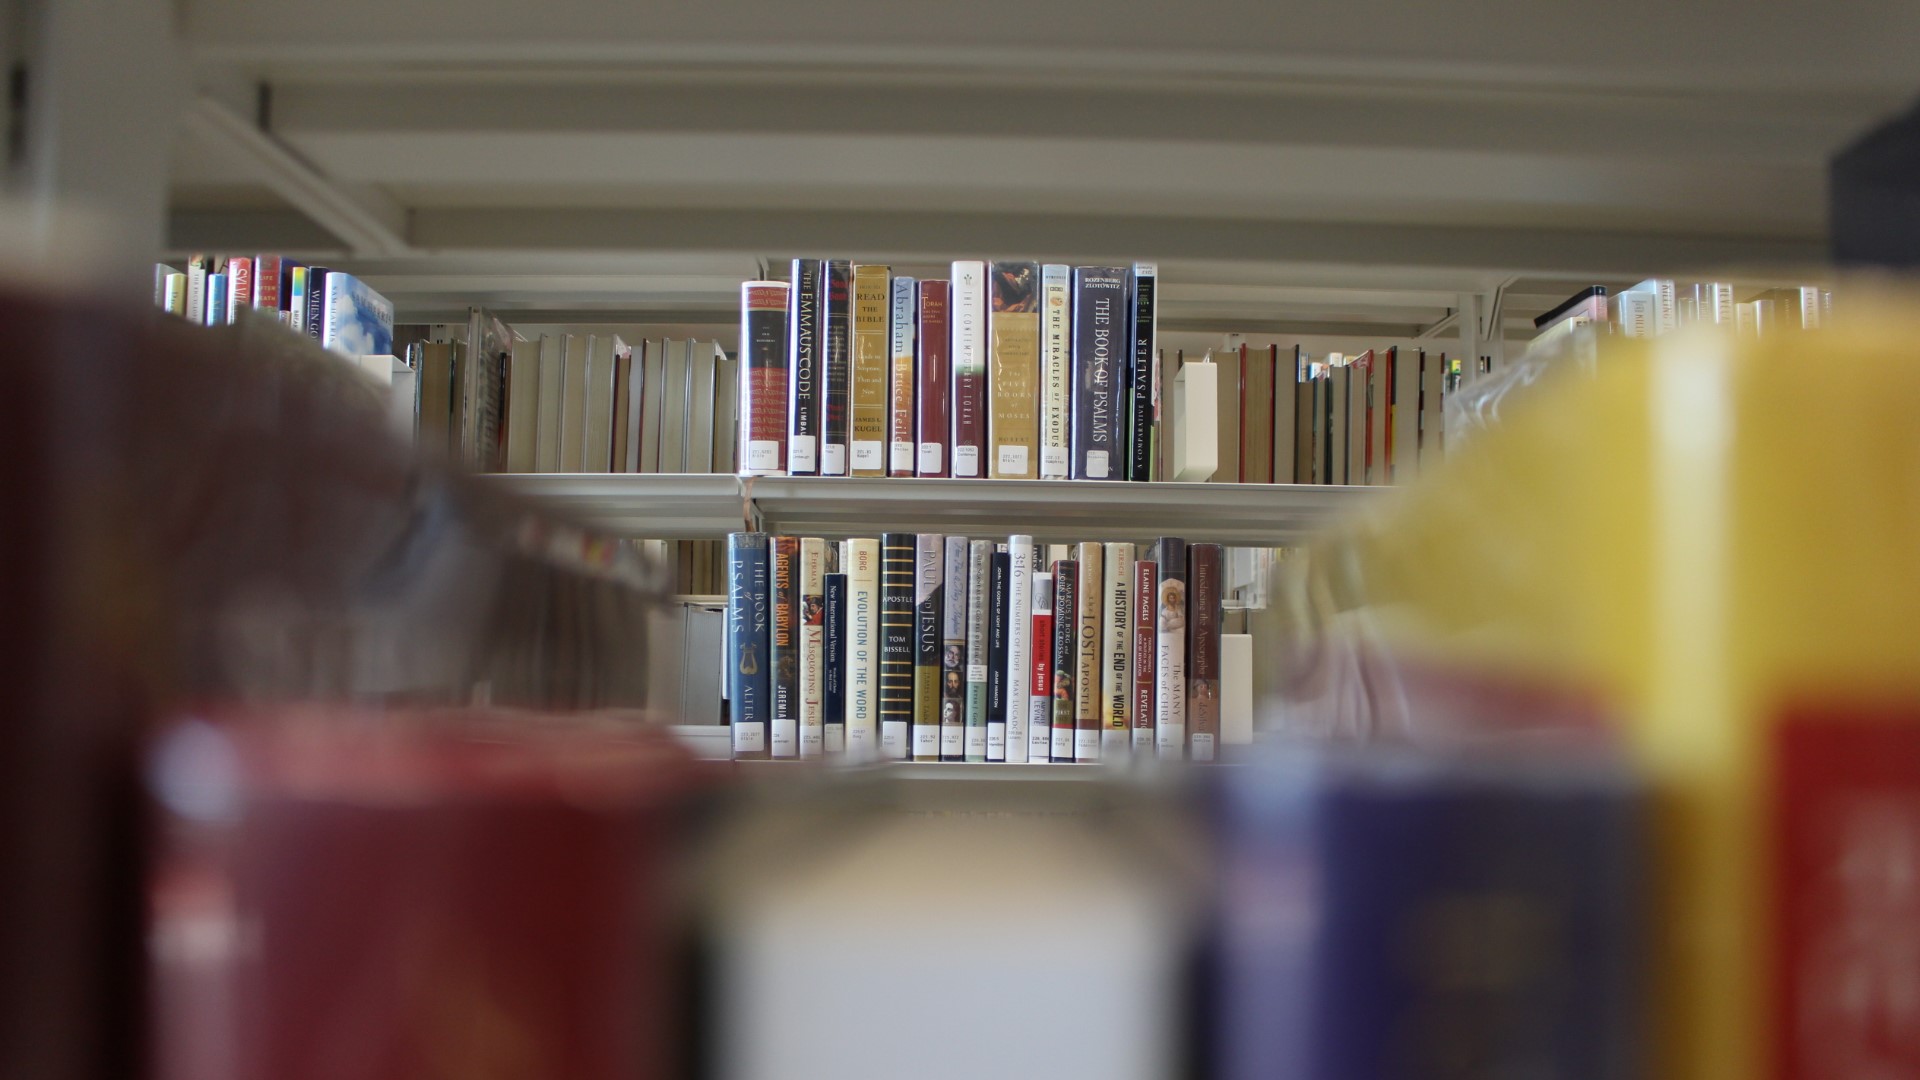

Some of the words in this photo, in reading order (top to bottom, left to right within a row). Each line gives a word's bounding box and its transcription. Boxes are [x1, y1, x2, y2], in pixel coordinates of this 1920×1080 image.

[803, 270, 812, 290] THE
[311, 290, 320, 321] WHEN
[895, 283, 909, 353] Abraham
[921, 296, 943, 309] TORAH
[1052, 309, 1060, 328] THE
[1095, 298, 1110, 325] THE
[799, 293, 813, 354] EMMAUS
[1052, 334, 1060, 388] MIRACLES
[1095, 329, 1109, 367] BOOK
[798, 357, 812, 400] CODE
[895, 363, 908, 402] Bruce
[1094, 369, 1108, 387] OF
[1136, 338, 1148, 399] PSALTER
[895, 408, 908, 443] Feile
[1051, 407, 1060, 448] EXODUS
[1092, 391, 1108, 442] PSALMS
[754, 561, 764, 587] THE
[776, 553, 790, 589] AGENTS
[810, 552, 819, 588] EHRMAN
[858, 550, 868, 571] BORG
[923, 550, 937, 588] PAUL
[1014, 553, 1026, 578] 3:16
[731, 560, 744, 633] PSALMS
[1058, 573, 1066, 593] JOHN
[1065, 583, 1073, 614] MARCUS
[1199, 564, 1209, 611] Introducing
[754, 593, 765, 632] BOOK
[775, 603, 789, 646] BABYLON
[829, 600, 838, 639] International
[856, 591, 868, 645] EVOLUTION
[1014, 598, 1022, 636] NUMBERS
[1057, 595, 1065, 629] DOMINIC
[1115, 589, 1127, 630] HISTORY
[1199, 615, 1209, 626] the
[920, 610, 936, 652] JESUS
[1082, 615, 1096, 661] LOST
[1116, 641, 1124, 651] THE
[805, 628, 822, 695] MISQUOTING
[829, 641, 837, 663] Version
[856, 650, 868, 662] OF
[1037, 663, 1045, 672] by
[1113, 652, 1126, 672] END
[1161, 645, 1170, 677] FACES
[1196, 628, 1209, 675] Apocrypha
[856, 667, 867, 685] THE
[1037, 672, 1046, 691] jesus
[1080, 662, 1090, 715] APOSTLE
[1115, 682, 1123, 692] THE
[1161, 681, 1170, 692] of
[1173, 664, 1182, 680] The
[744, 685, 754, 720] ALTER
[805, 697, 819, 727] JESUS
[856, 690, 867, 719] WORD
[1011, 700, 1019, 730] LUCADO
[1033, 700, 1041, 725] LEVINE
[1112, 694, 1125, 728] WORLD
[1161, 692, 1169, 724] CHRI
[1172, 683, 1182, 716] MANY
